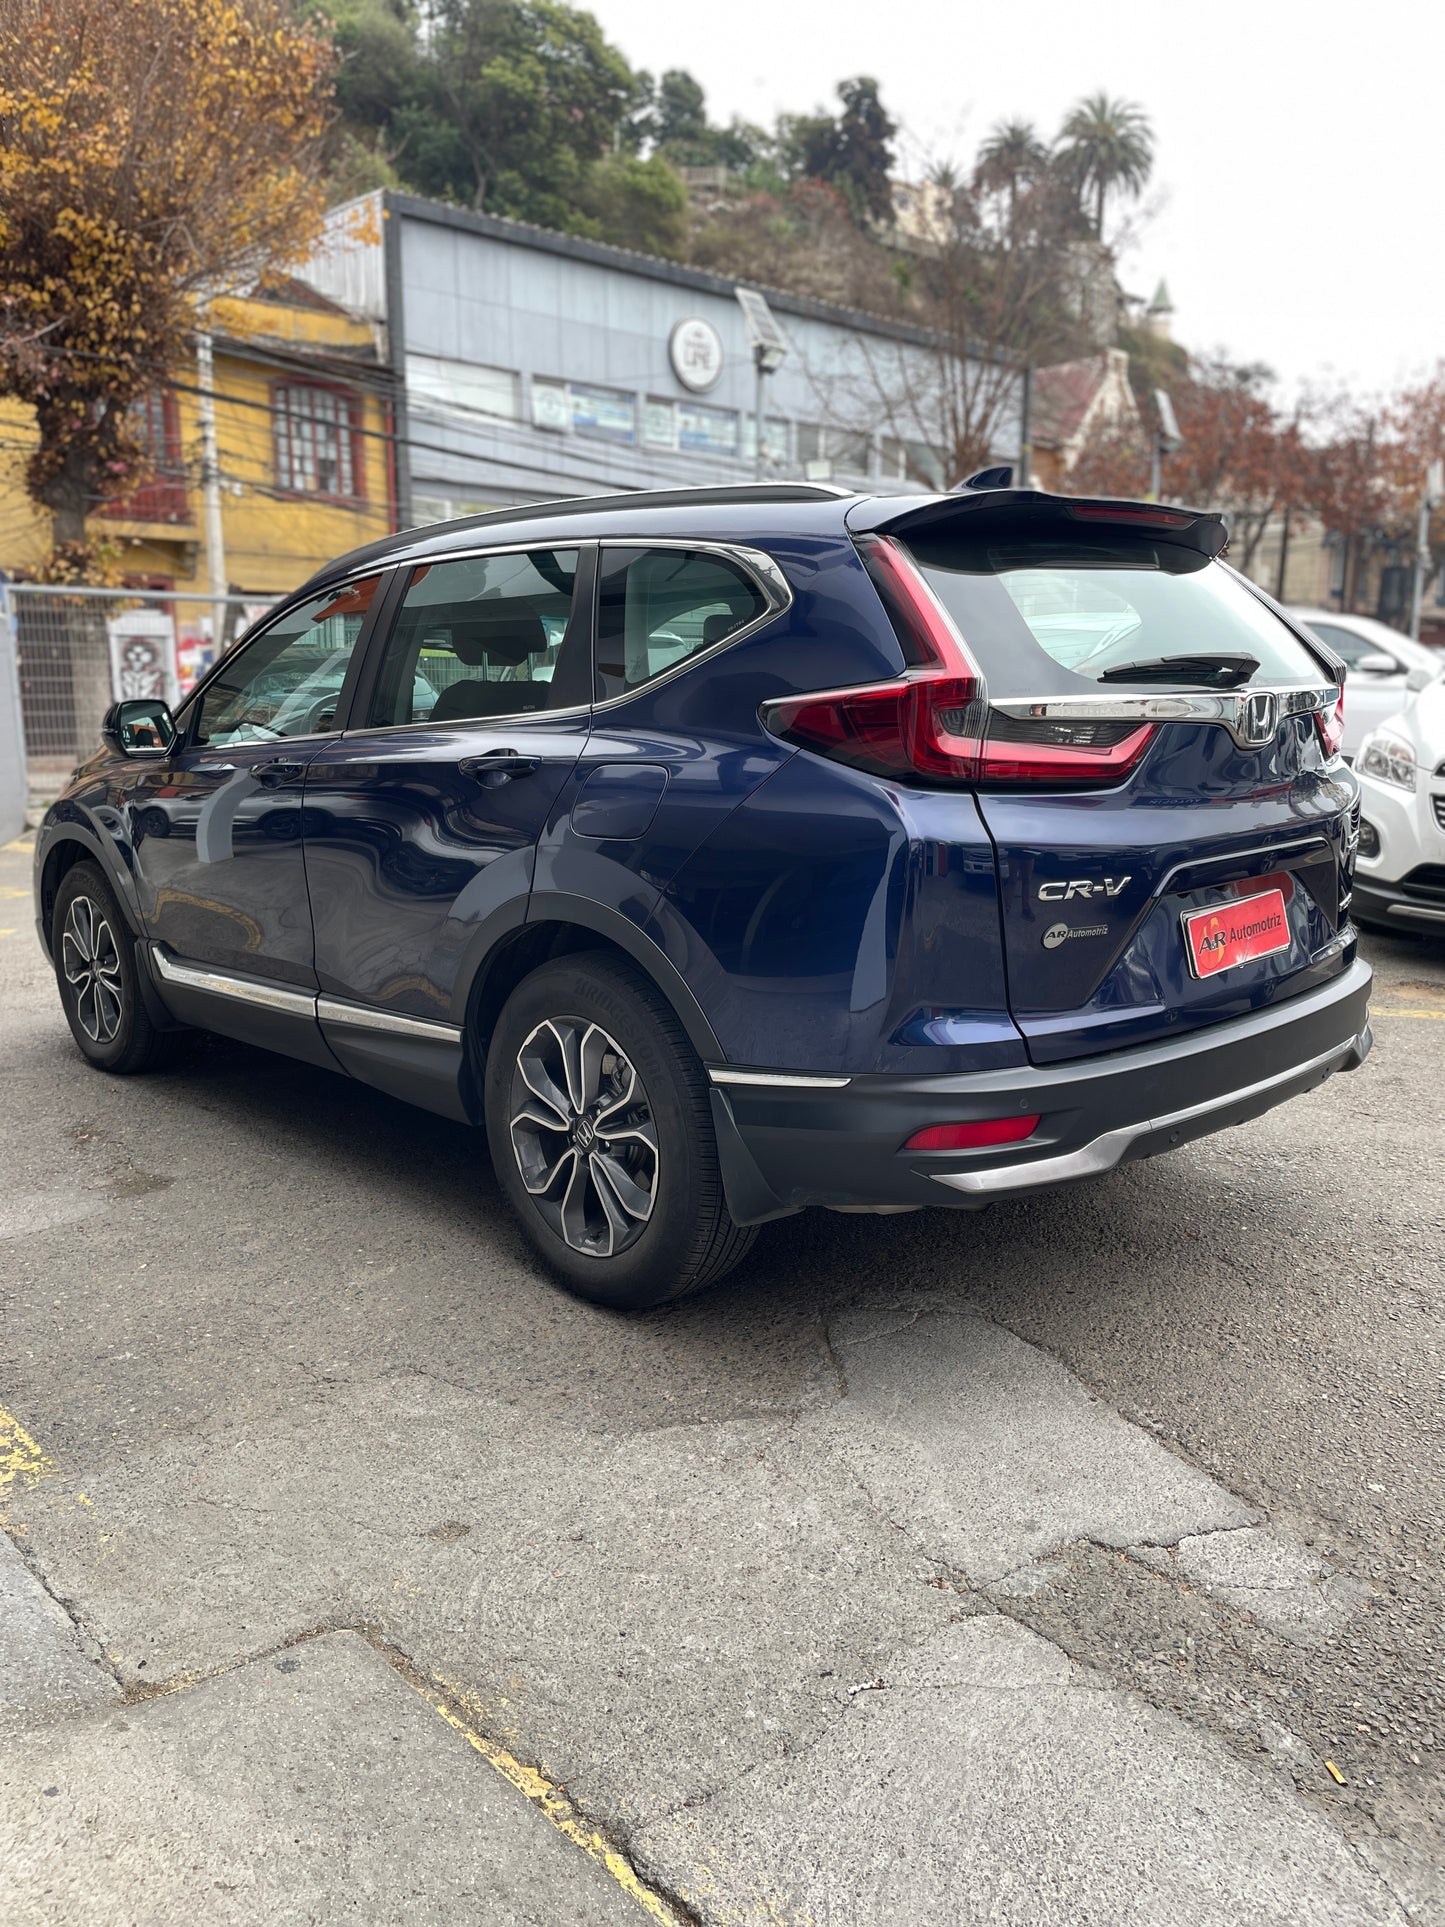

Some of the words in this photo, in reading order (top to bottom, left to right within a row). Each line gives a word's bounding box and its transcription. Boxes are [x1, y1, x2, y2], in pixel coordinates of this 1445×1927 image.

[1038, 877, 1132, 901] CR-V
[1067, 926, 1109, 938] Automotriz
[1229, 913, 1282, 943] Automotriz
